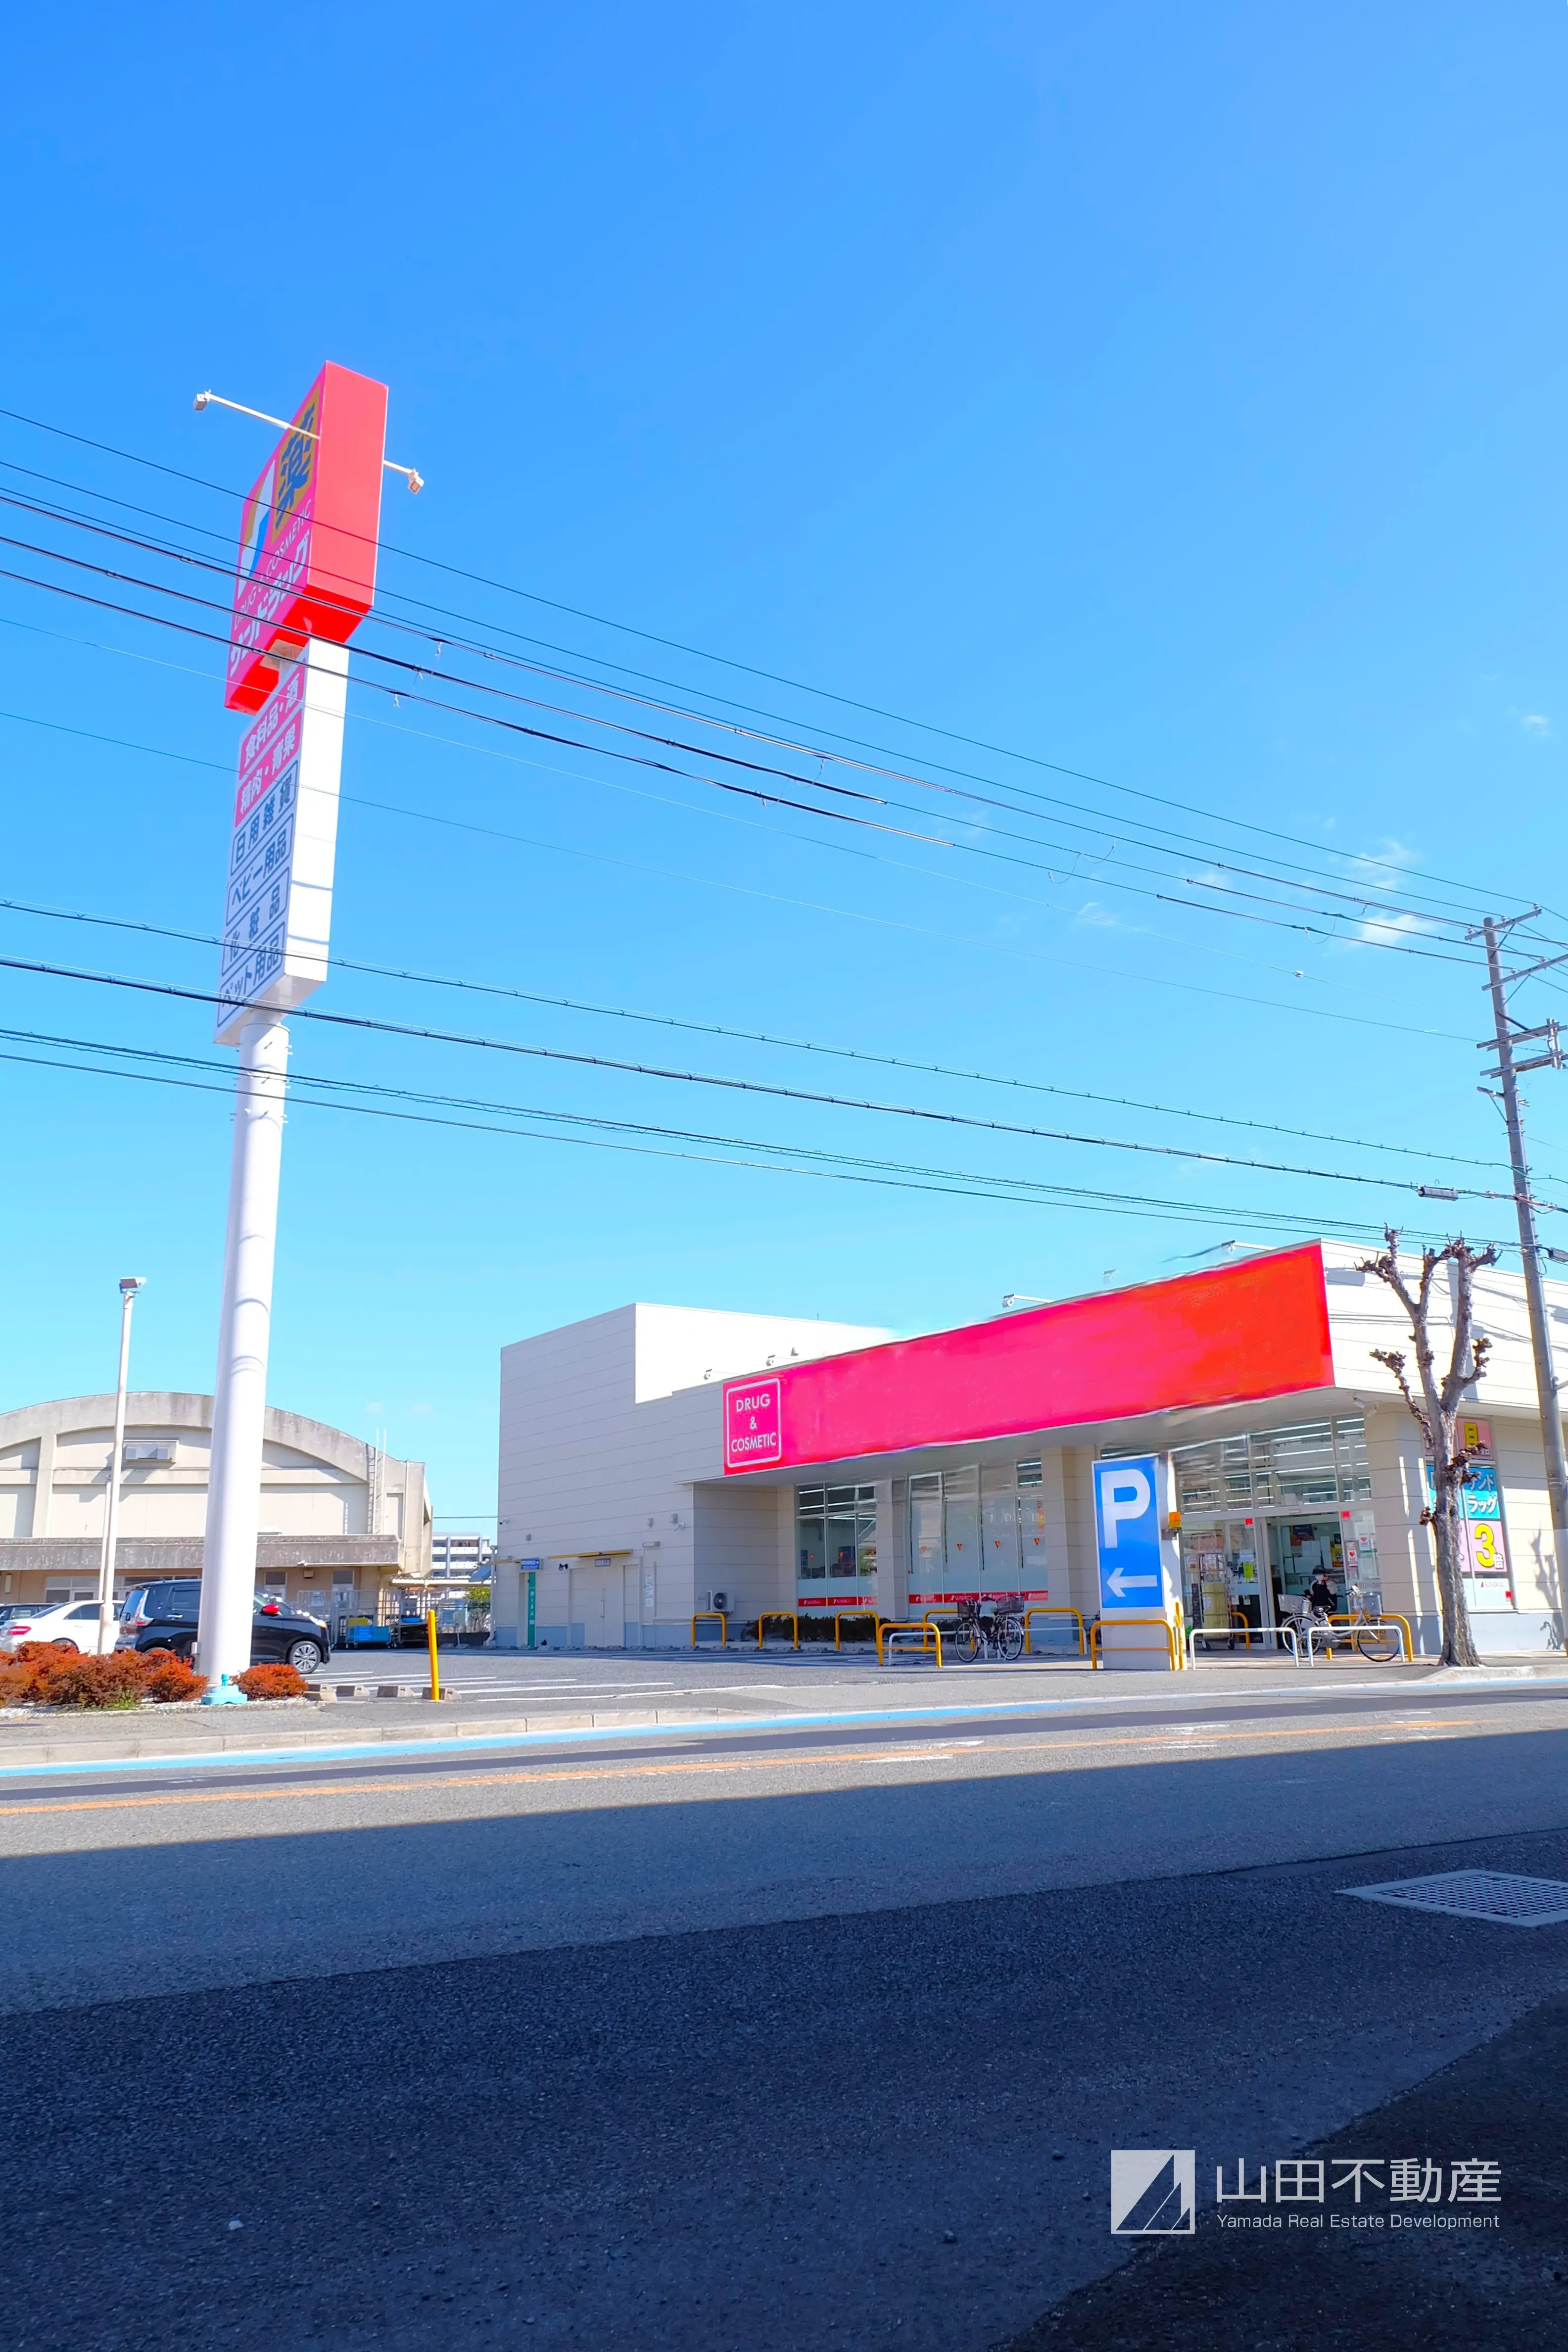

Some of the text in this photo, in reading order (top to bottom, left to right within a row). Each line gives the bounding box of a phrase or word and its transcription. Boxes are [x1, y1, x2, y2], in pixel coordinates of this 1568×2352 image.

[276, 402, 315, 530] 薬
[266, 498, 312, 577] COSMETIC
[230, 528, 311, 677] サンドラッグ
[244, 673, 299, 768] 食料品・酒
[236, 773, 292, 864] 日用雑貨
[232, 828, 286, 906] ベビー用品
[230, 884, 280, 962] 化粧品
[731, 1432, 777, 1452] COSMETIC
[736, 1393, 770, 1413] DRUG
[750, 1416, 757, 1430] &
[1100, 1469, 1150, 1548] P
